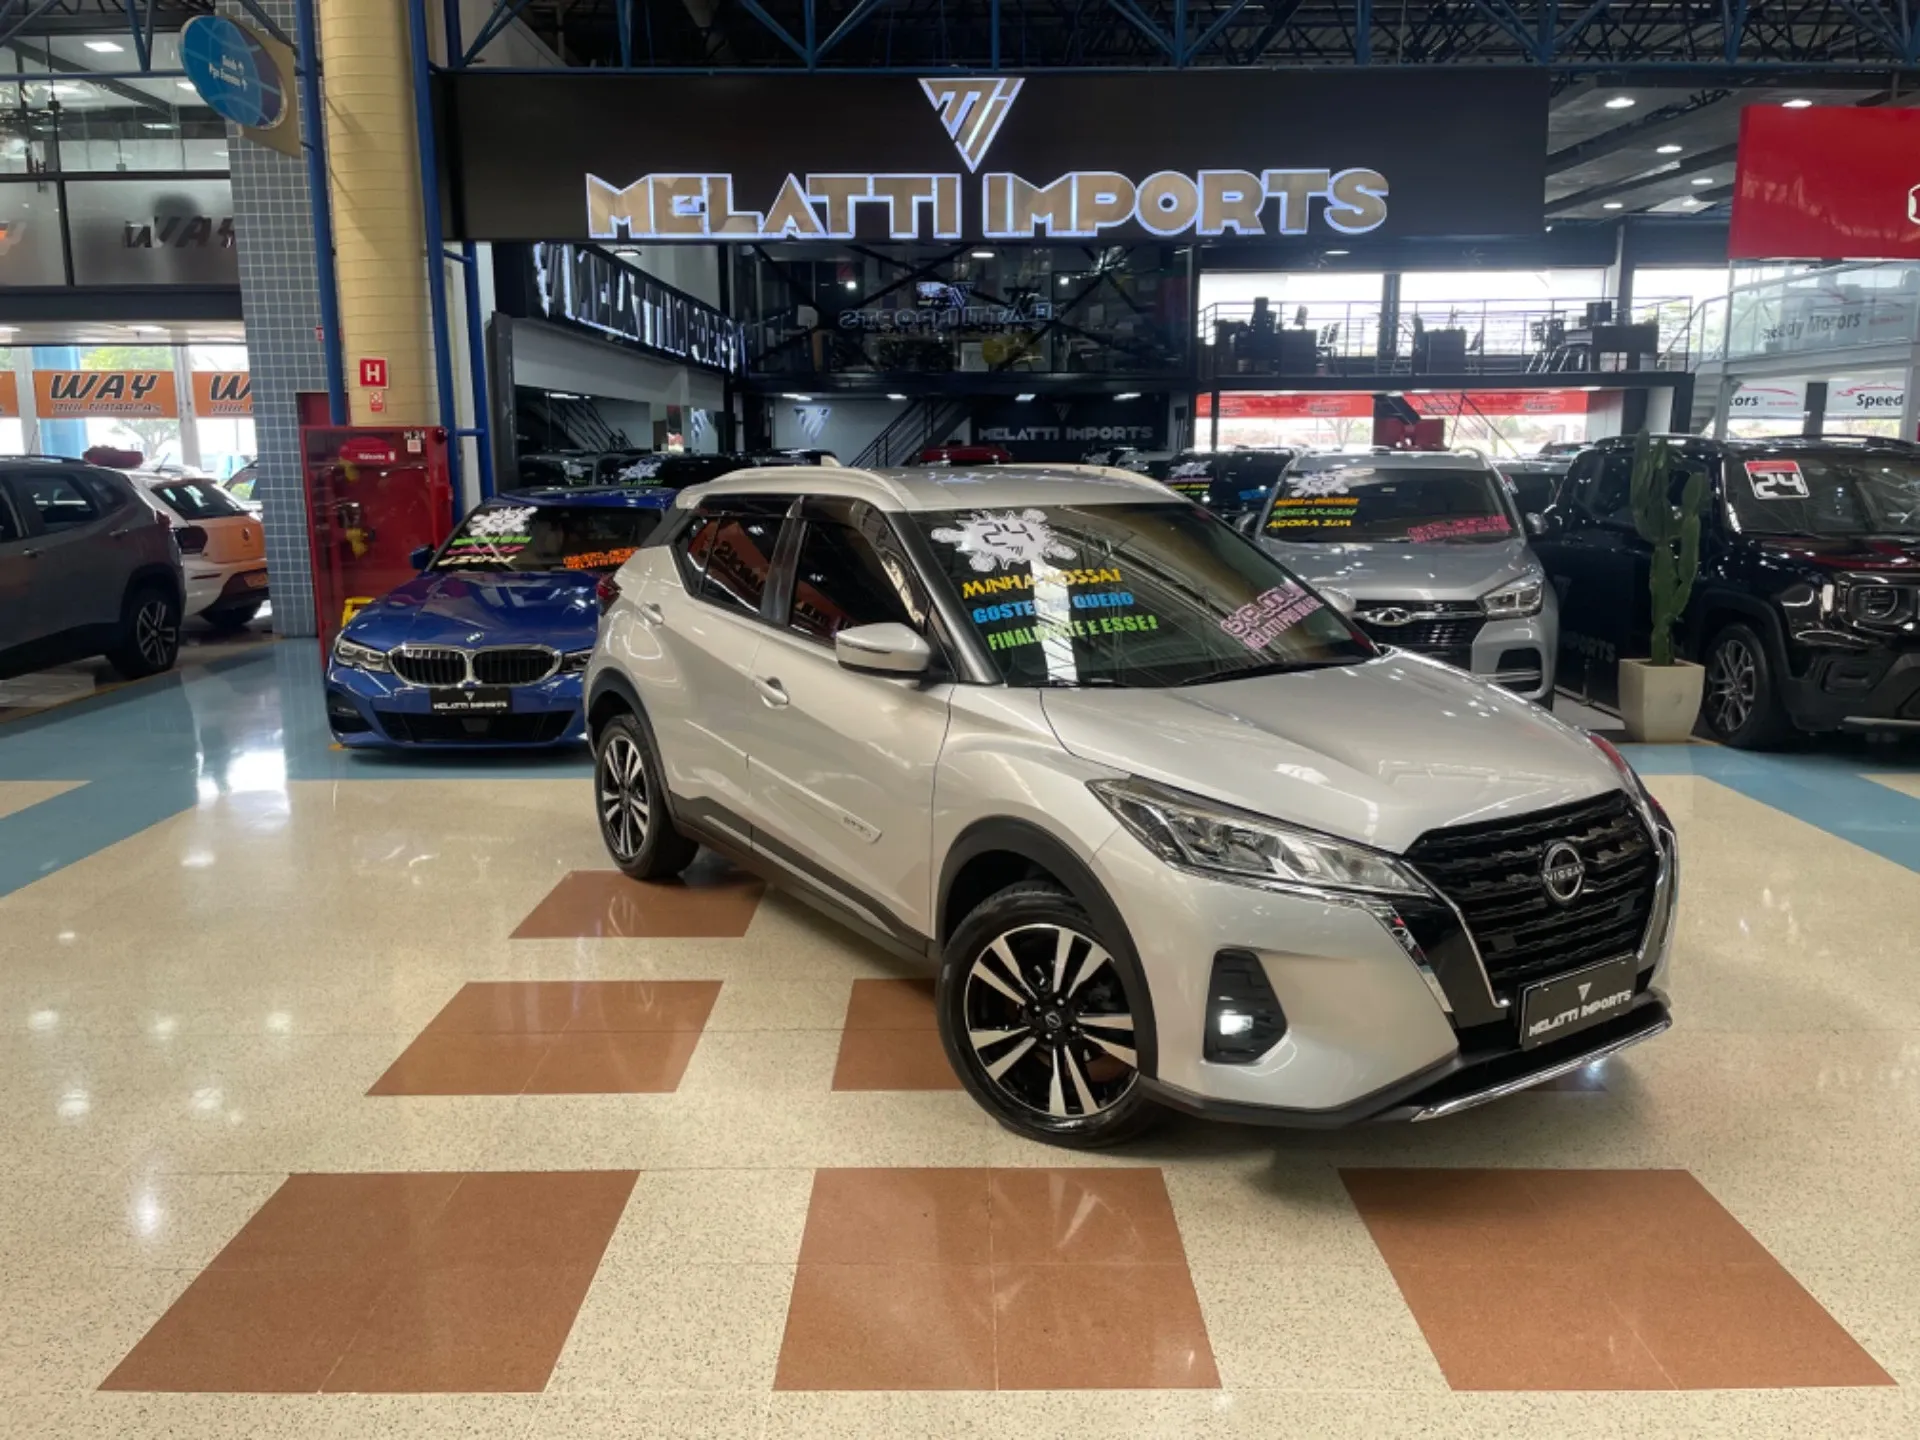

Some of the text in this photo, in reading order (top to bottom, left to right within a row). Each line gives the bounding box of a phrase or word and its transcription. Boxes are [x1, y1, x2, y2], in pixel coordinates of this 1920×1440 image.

[586, 167, 1389, 239] MELATTI IMPORTS
[366, 363, 380, 382] H
[50, 373, 158, 400] WAY
[979, 426, 1153, 441] MELATTI IMPORTS
[1755, 472, 1806, 496] 24
[977, 520, 1036, 547] 24
[962, 570, 1037, 600] MINHA
[1072, 592, 1134, 609] QUERO
[1101, 615, 1159, 633] ESSE!
[1529, 989, 1632, 1037] MELATTI IMPORTS
